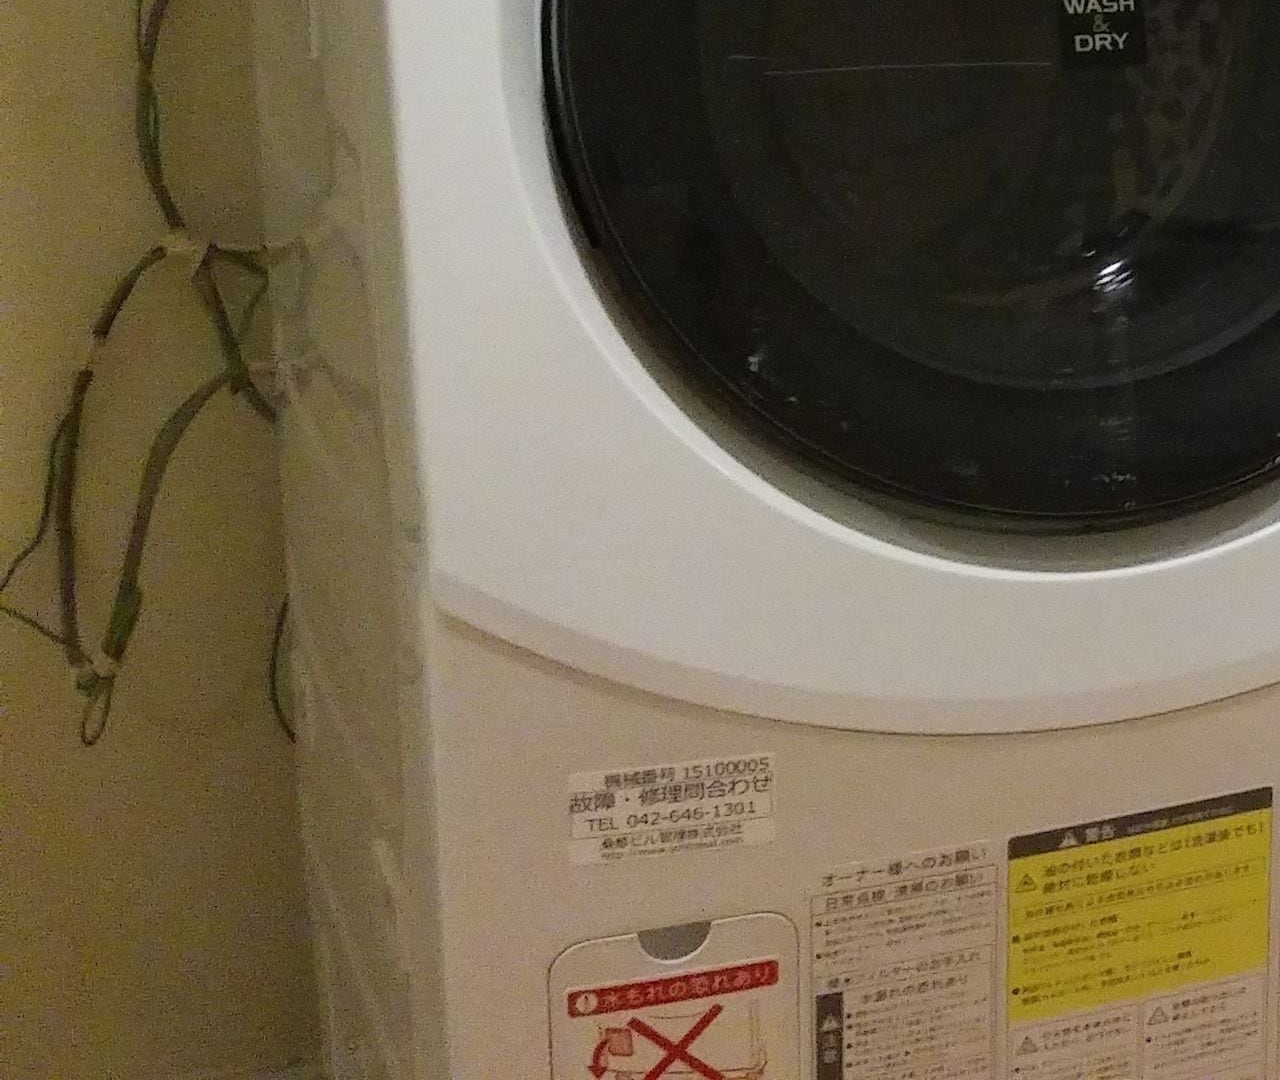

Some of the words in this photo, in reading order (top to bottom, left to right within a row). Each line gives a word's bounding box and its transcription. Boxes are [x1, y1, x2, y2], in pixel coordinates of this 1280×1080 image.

[1092, 14, 1110, 32] &
[1073, 32, 1129, 52] DRY
[684, 757, 769, 780] 15100005
[586, 817, 619, 832] TEL
[626, 801, 756, 828] 042-646-1301
